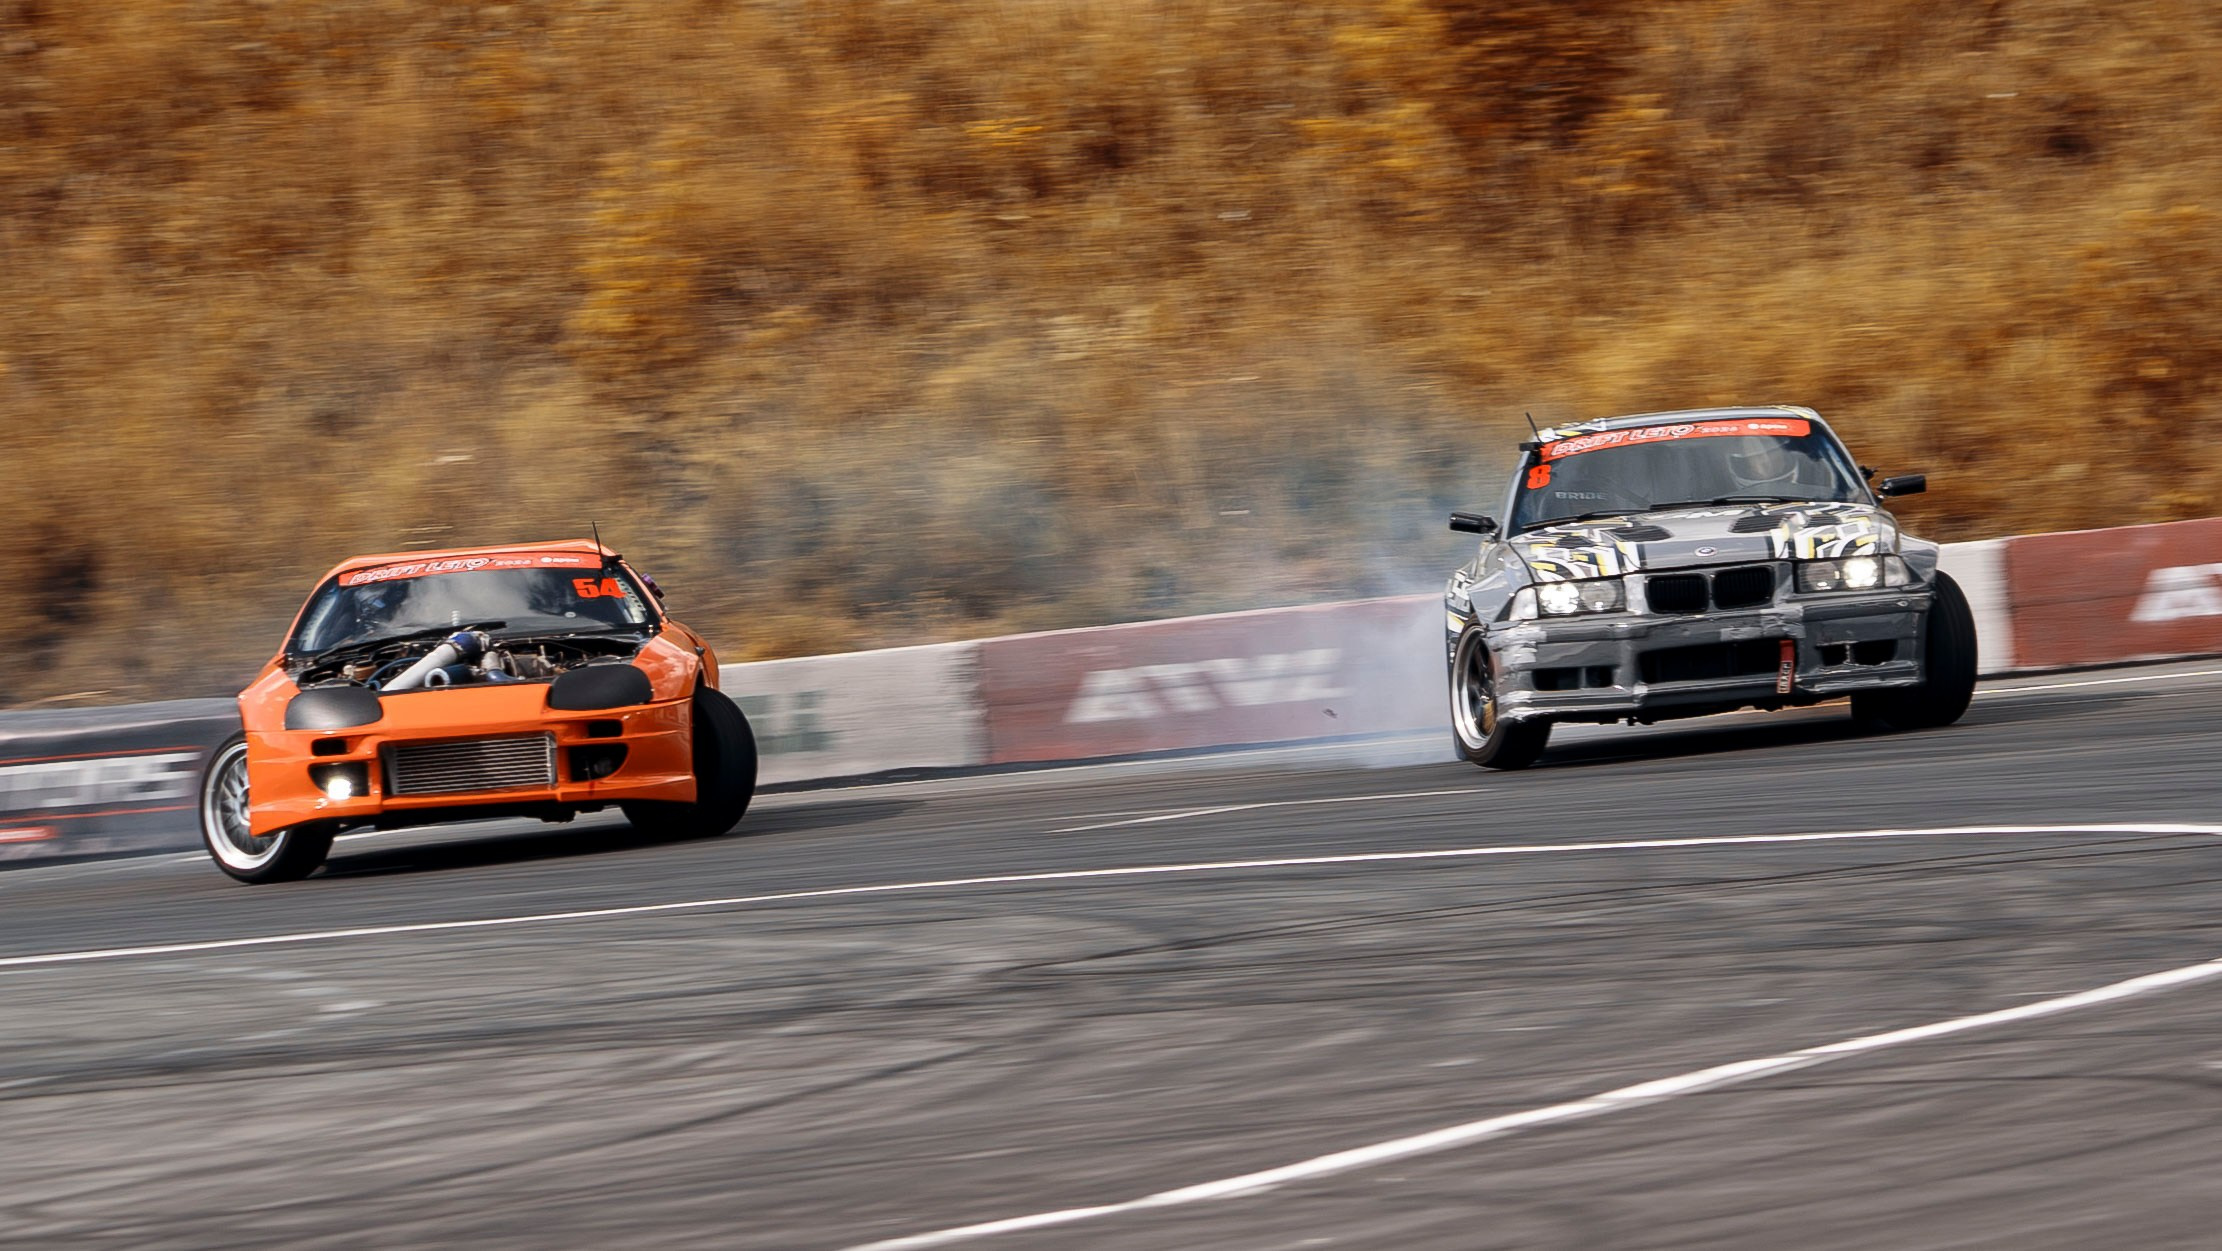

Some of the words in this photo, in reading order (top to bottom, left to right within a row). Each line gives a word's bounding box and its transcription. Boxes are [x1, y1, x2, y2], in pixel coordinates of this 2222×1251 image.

[1551, 431, 1630, 456] DRIFT
[1629, 424, 1696, 440] LETO
[1527, 464, 1551, 489] 8
[1554, 491, 1609, 500] BRIDE
[349, 563, 427, 586] DRIFT
[425, 557, 489, 573] LETO
[573, 578, 627, 598] 54
